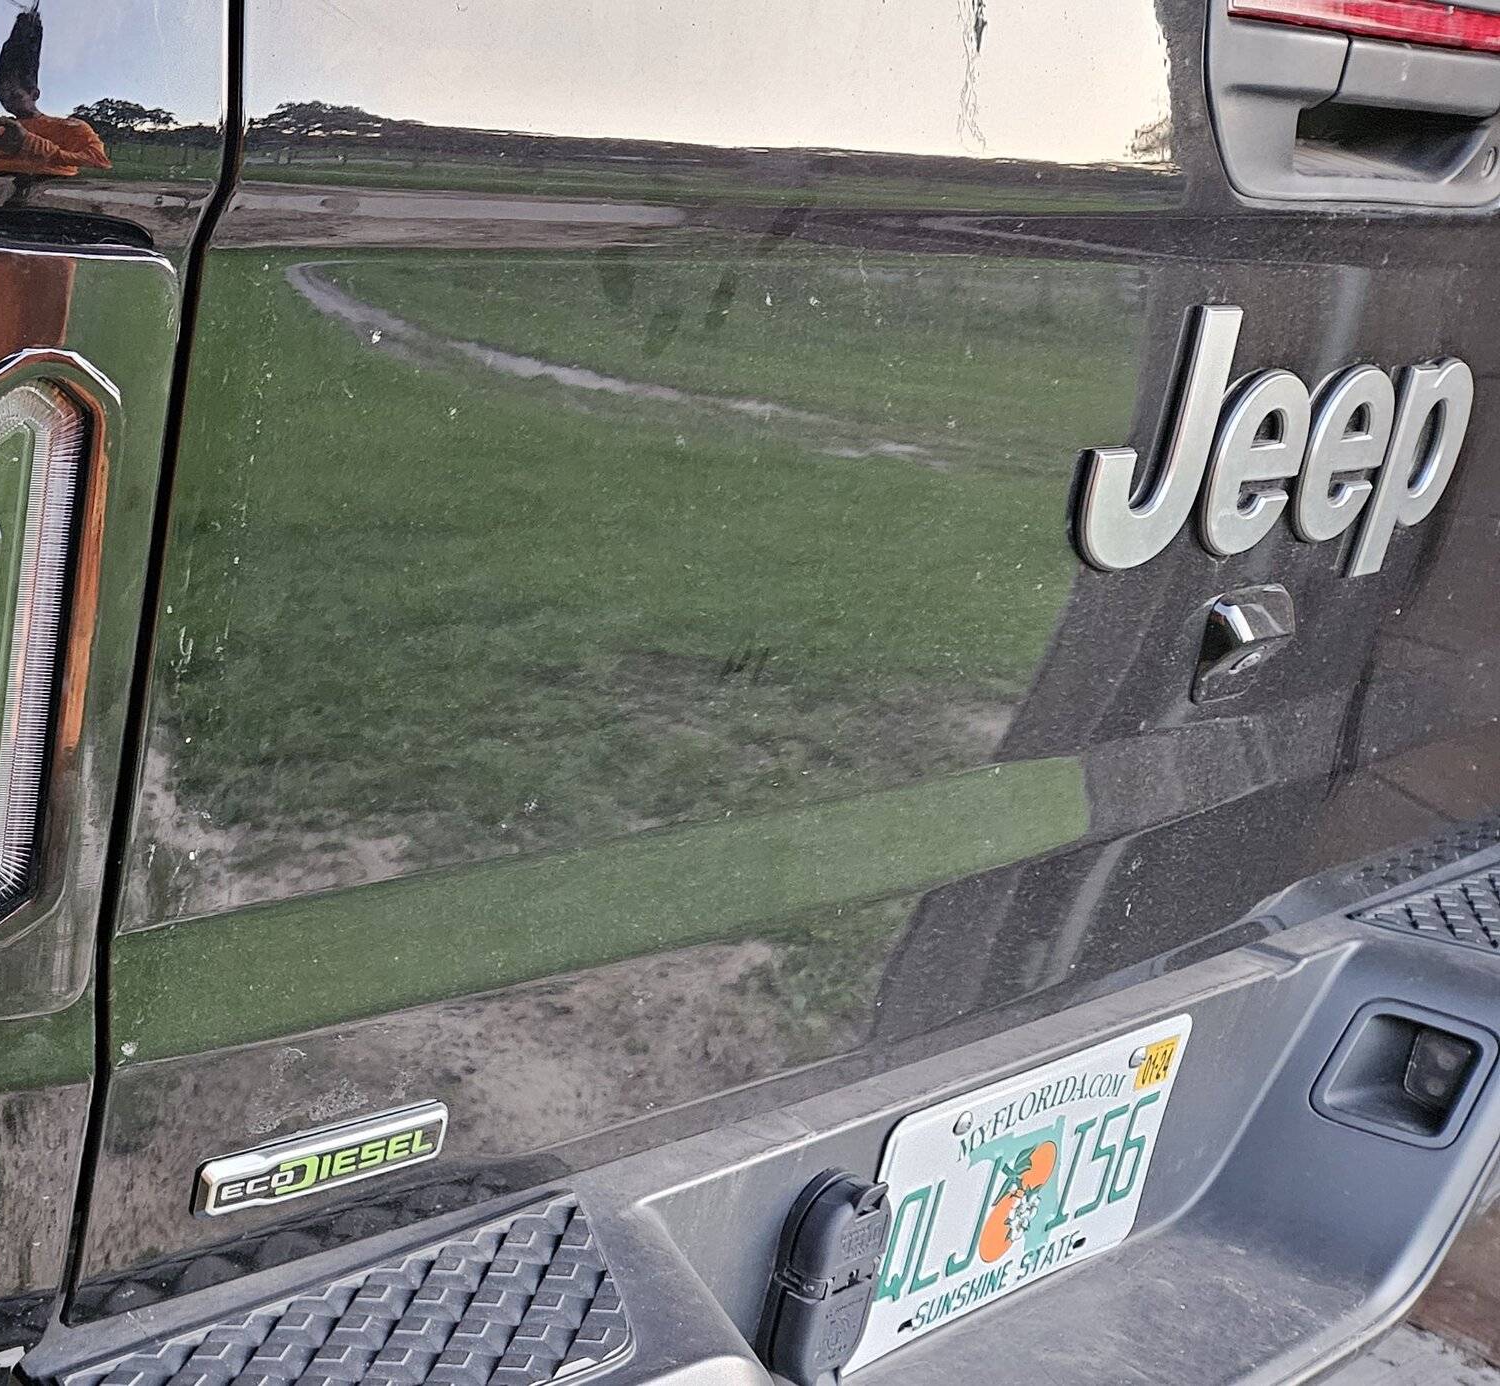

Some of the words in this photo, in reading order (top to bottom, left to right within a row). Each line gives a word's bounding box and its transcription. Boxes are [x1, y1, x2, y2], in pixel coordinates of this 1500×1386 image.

[1070, 304, 1475, 579] Jeep
[956, 1072, 1127, 1162] MYFLORIDA.COM
[911, 1259, 1014, 1331] SUNSHINE
[1016, 1230, 1081, 1281] STATE
